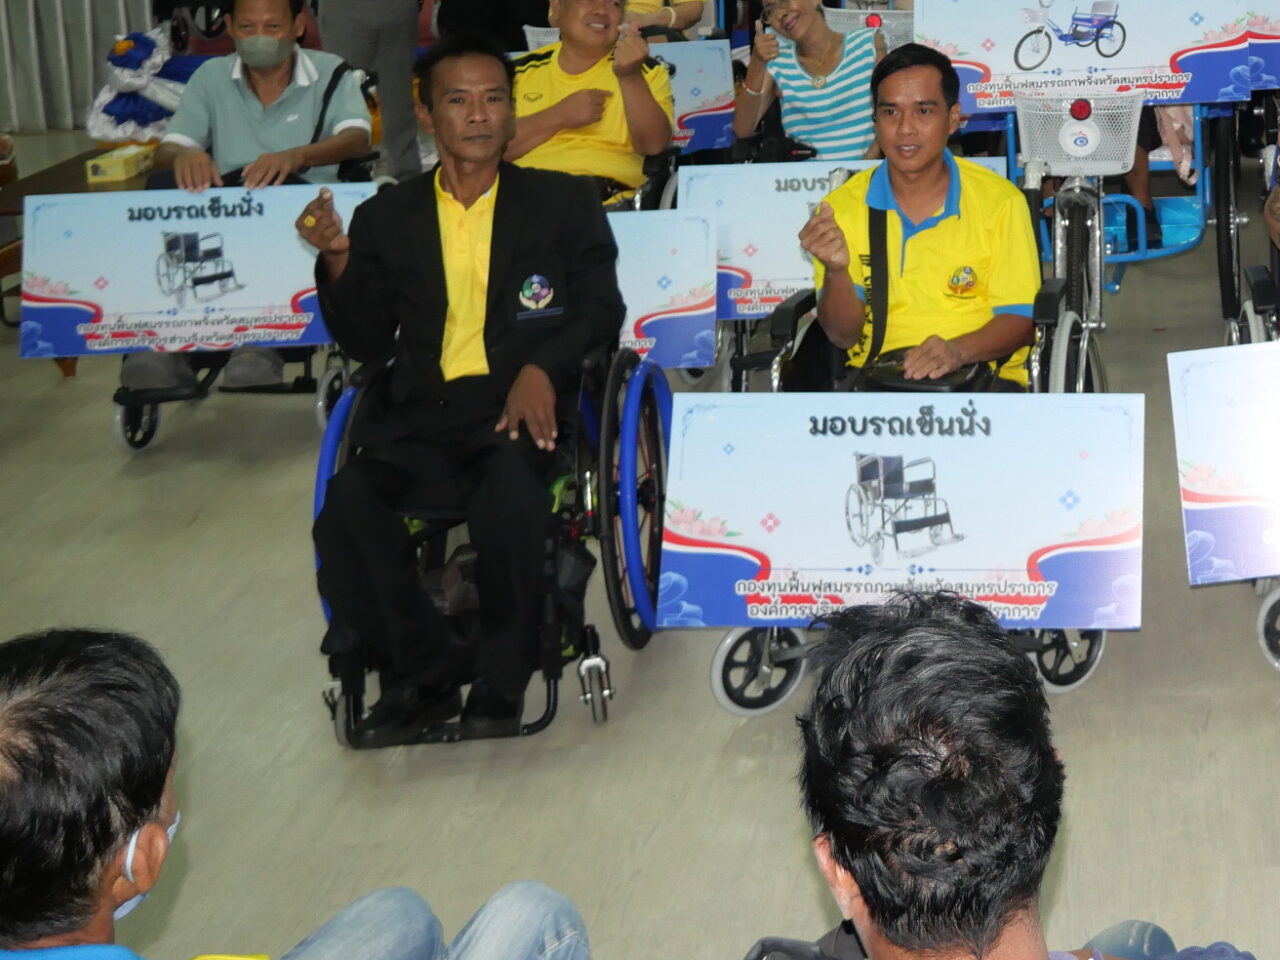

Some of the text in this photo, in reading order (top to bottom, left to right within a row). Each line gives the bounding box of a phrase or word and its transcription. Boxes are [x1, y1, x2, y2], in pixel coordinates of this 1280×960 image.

[967, 72, 1191, 93] กองทุนฟื้นฟสมรรถภาพจังหวัดสมุทรปราการ
[128, 190, 265, 222] มอบรถเข็นนั่ง
[809, 400, 992, 438] มอบรถเข็นนั่ง
